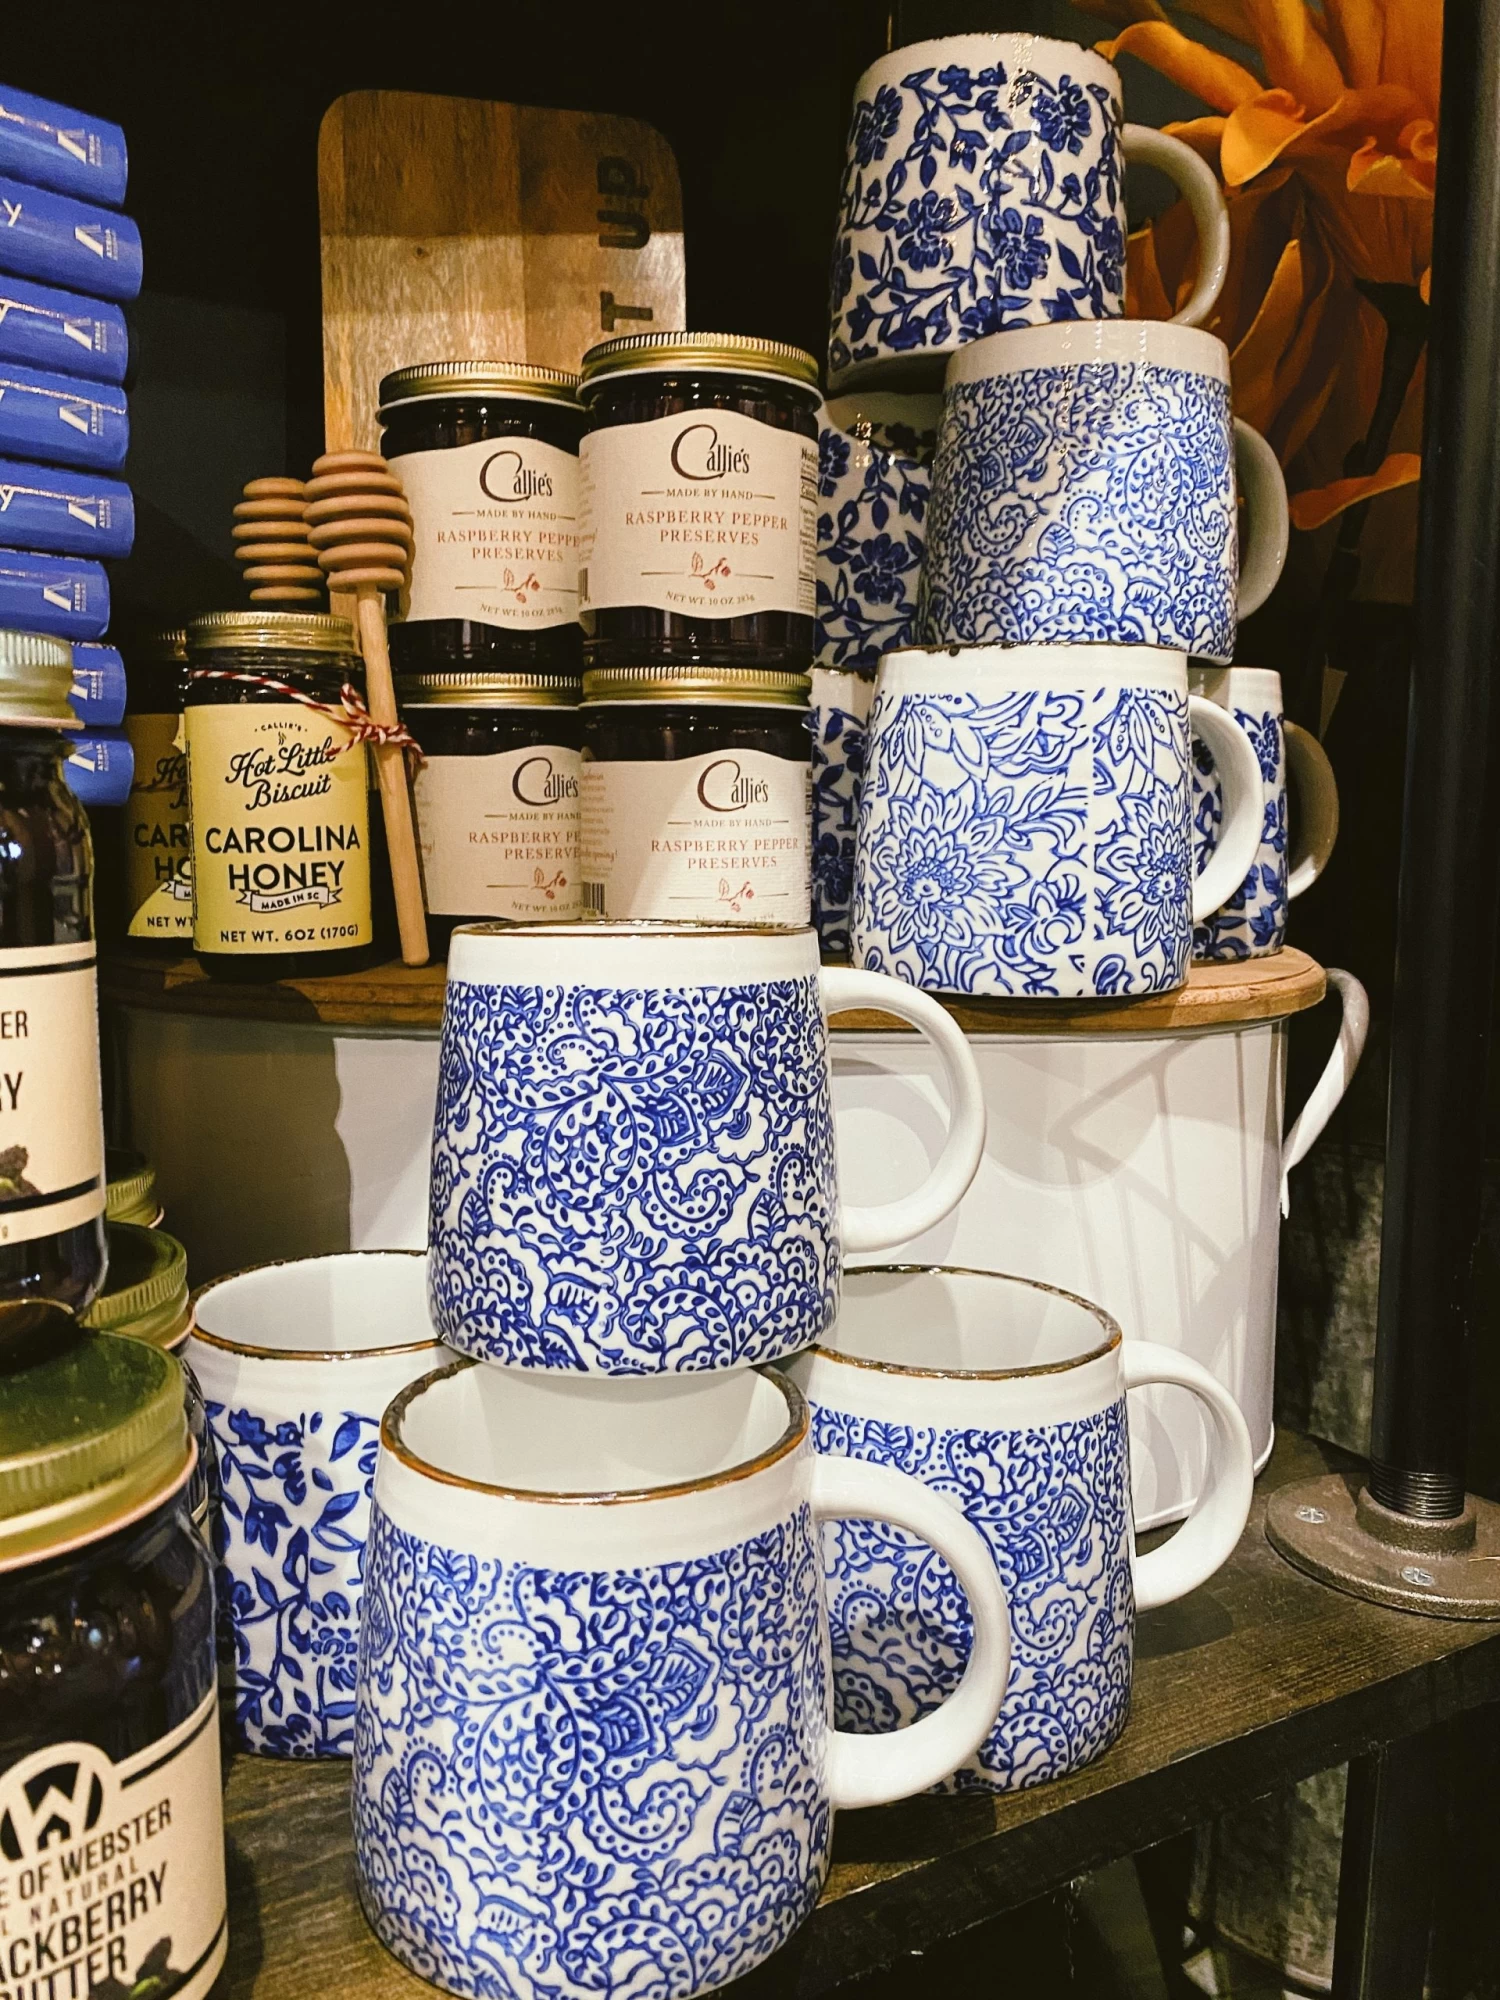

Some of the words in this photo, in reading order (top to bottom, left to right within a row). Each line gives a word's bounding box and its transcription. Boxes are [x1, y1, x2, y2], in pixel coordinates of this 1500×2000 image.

[670, 423, 750, 481] Callie's
[479, 450, 553, 503] Callie's
[666, 488, 700, 497] MADE
[703, 489, 718, 497] BY
[721, 489, 753, 500] HAND
[476, 509, 508, 519] MADE
[512, 510, 525, 519] BY
[528, 510, 557, 521] HAND
[625, 511, 725, 525] RASPBERRY
[732, 513, 788, 530] PEPPER
[437, 530, 533, 543] RASPBERRY
[538, 531, 581, 548] PEPPE
[660, 529, 759, 545] PRESERVES
[472, 547, 563, 561] PRESERVES
[225, 748, 276, 787] Hot
[512, 757, 579, 806] Callie's
[697, 759, 769, 812] Callie's
[245, 774, 331, 810] Biscuit
[509, 812, 539, 821] MADE
[542, 813, 554, 821] BY
[694, 819, 725, 828] MADE
[729, 819, 742, 827] BY
[745, 819, 772, 827] HAND
[205, 824, 361, 854] CAROLINA
[469, 831, 562, 843] RASPBERRY
[651, 839, 749, 853] RASPBERRY
[755, 837, 799, 850] PEPPER
[504, 848, 581, 860] PRESERVE
[688, 856, 777, 869] PRESERVES
[229, 860, 345, 891] HONEY
[261, 898, 291, 910] MADE
[293, 895, 305, 904] IN
[307, 892, 319, 901] SC
[147, 916, 170, 928] NET
[220, 930, 246, 942] NET
[251, 930, 279, 942] WT.
[320, 923, 359, 939] (170G)
[19, 1860, 52, 1900] OF
[60, 1797, 172, 1882] WEBSTER
[30, 1854, 139, 1924] NATURAL
